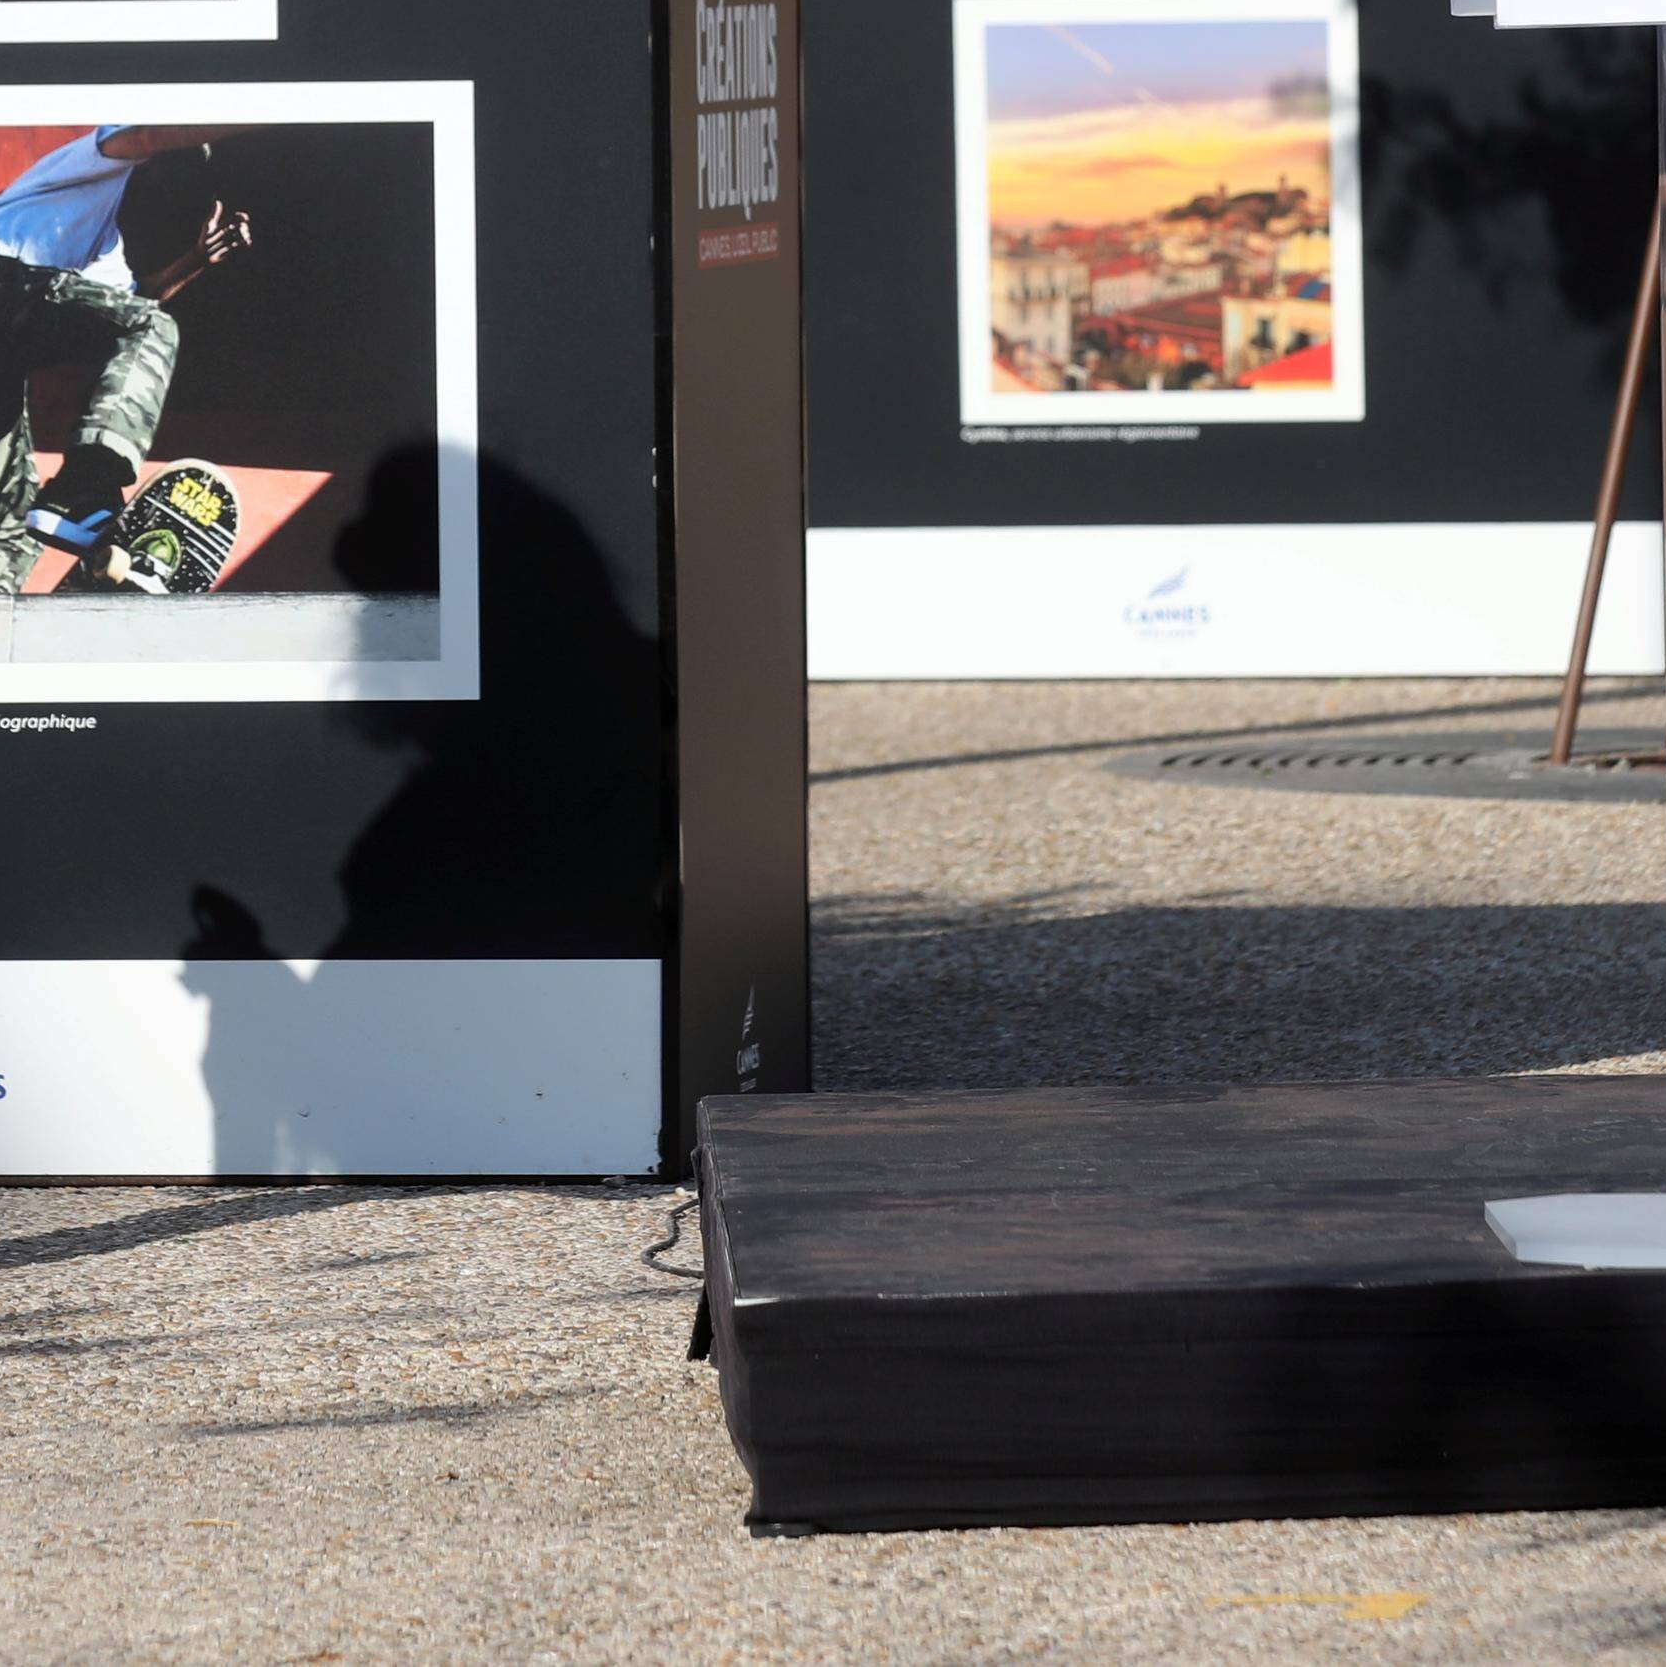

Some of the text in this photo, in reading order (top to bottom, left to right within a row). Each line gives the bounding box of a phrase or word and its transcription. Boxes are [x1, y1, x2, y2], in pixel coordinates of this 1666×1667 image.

[697, 107, 779, 221] PUBLIQUES
[169, 487, 221, 527] WARS
[174, 477, 222, 511] STAR
